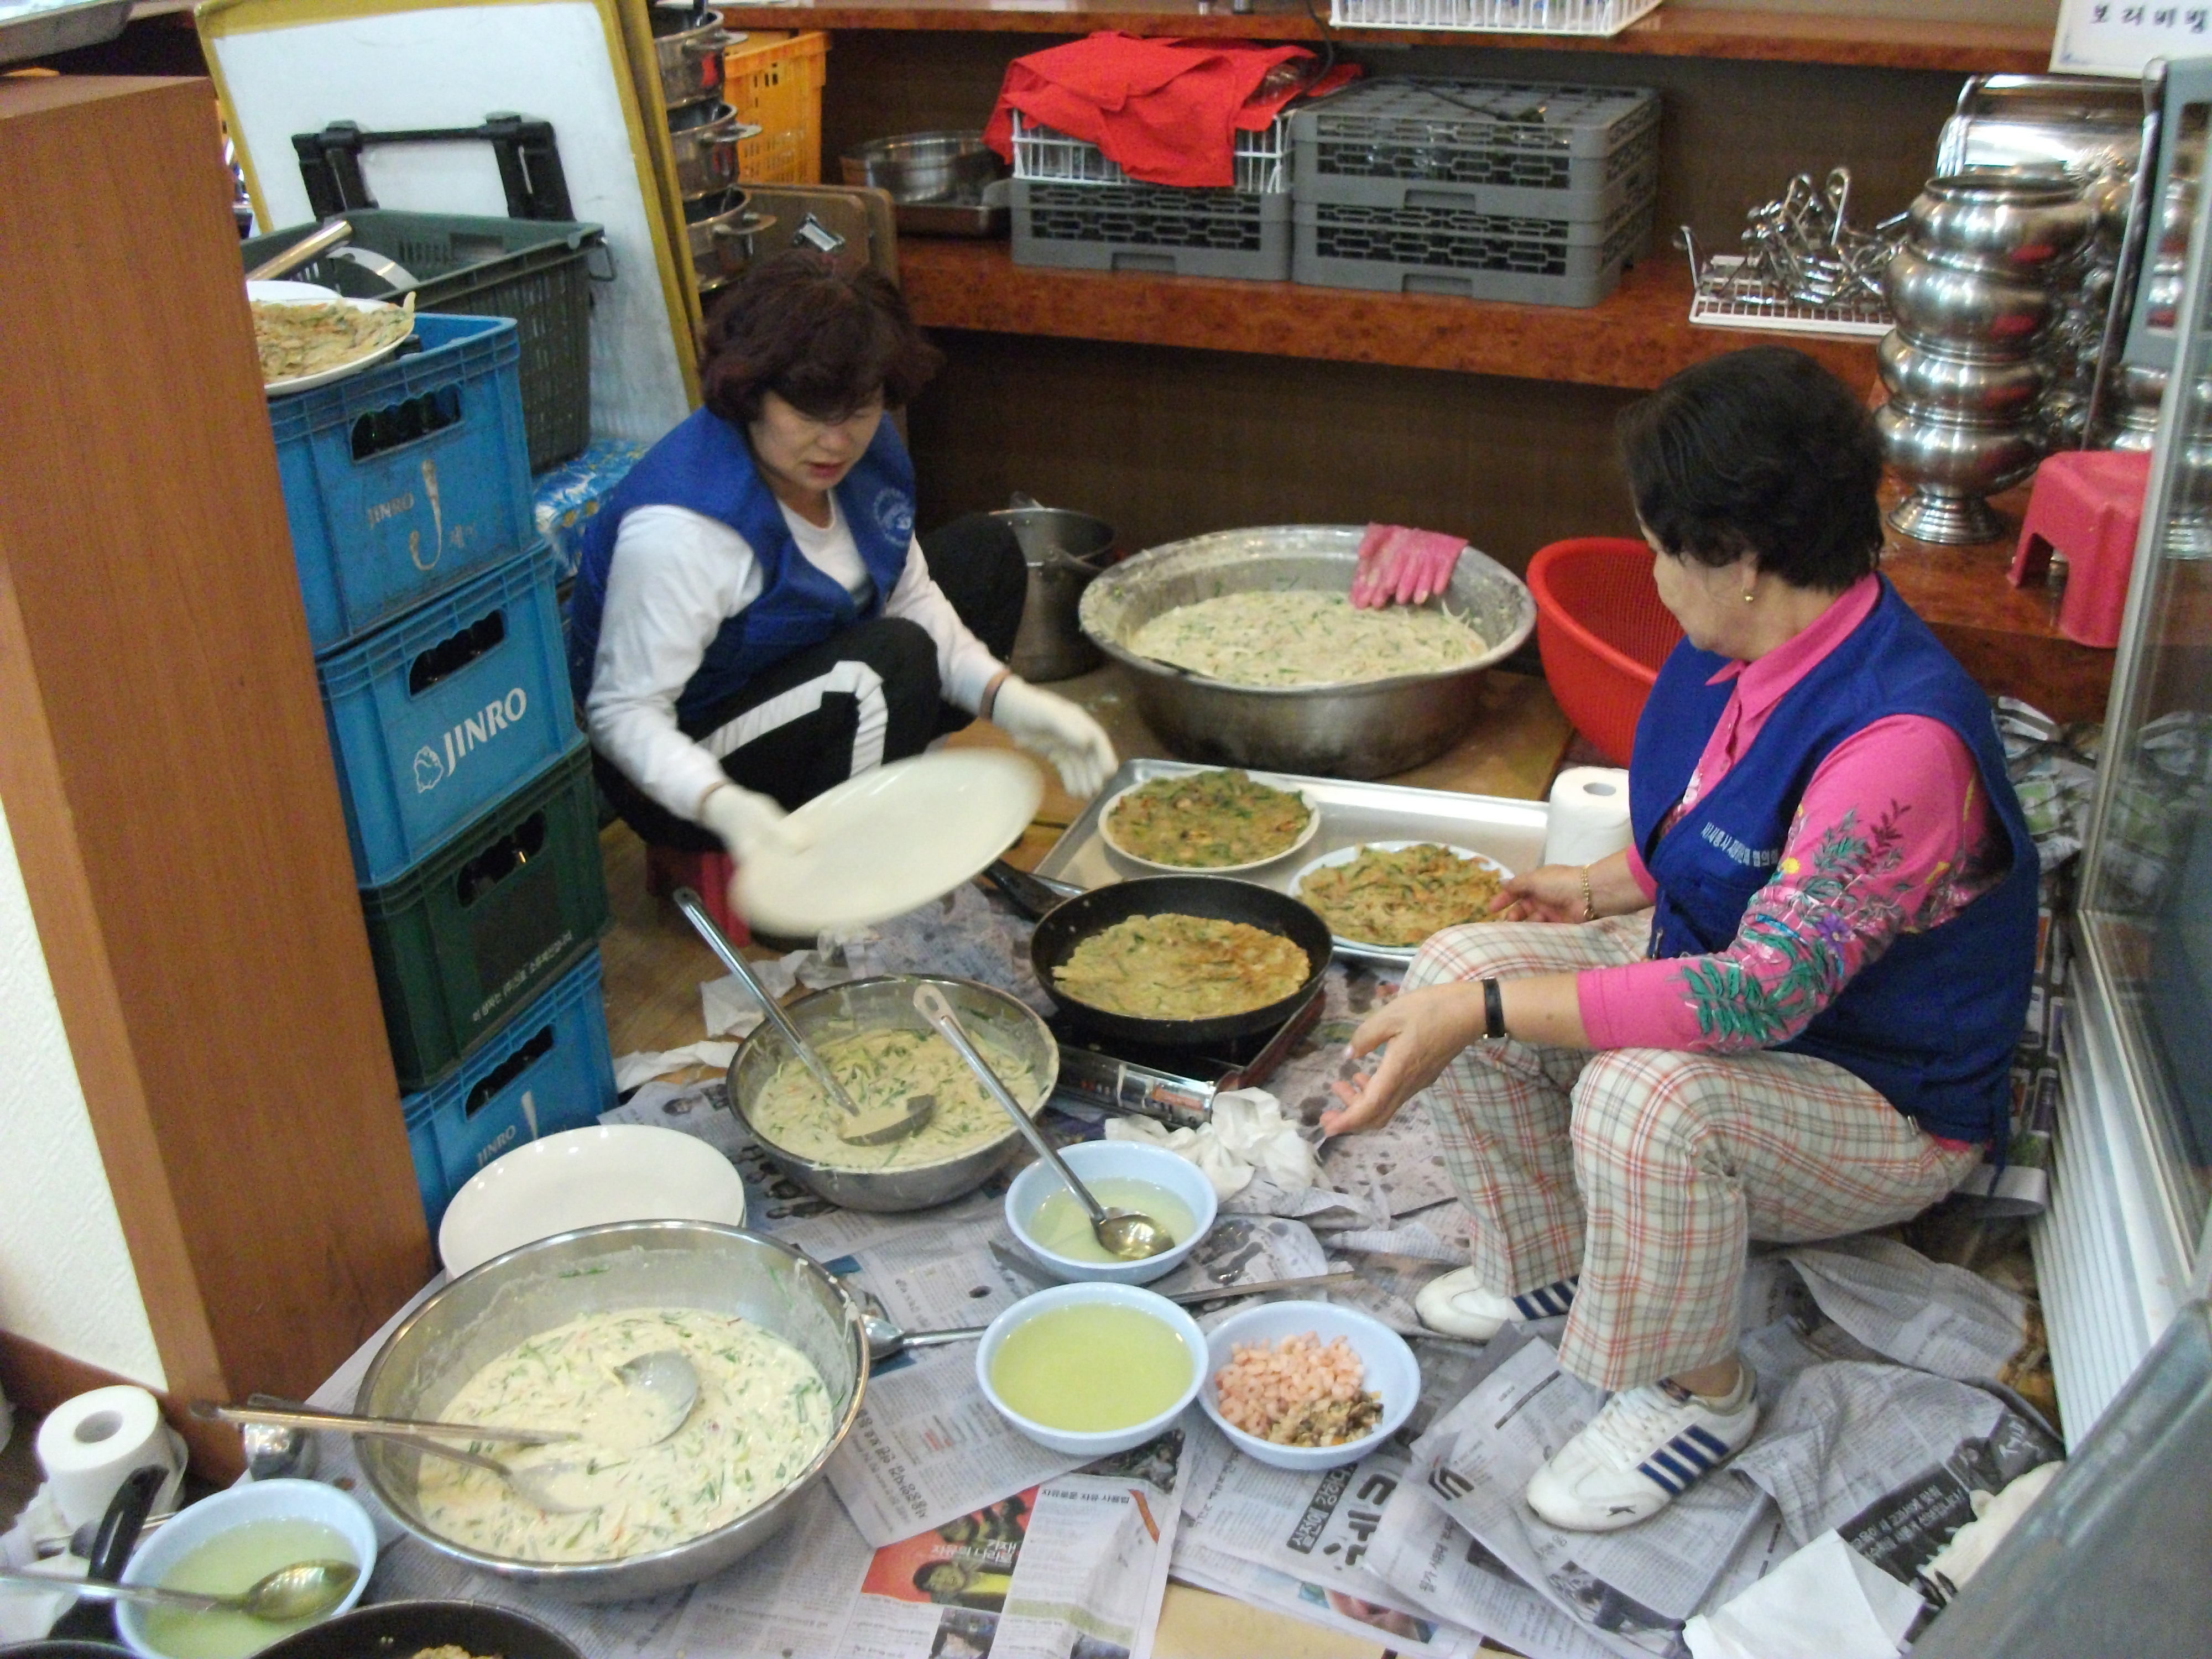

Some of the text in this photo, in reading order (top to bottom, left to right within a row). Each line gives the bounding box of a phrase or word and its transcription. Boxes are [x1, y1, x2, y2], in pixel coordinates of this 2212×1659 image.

[368, 492, 414, 530] JINRO
[444, 687, 527, 778] JINRO
[1292, 1506, 1329, 1548] 실전에
